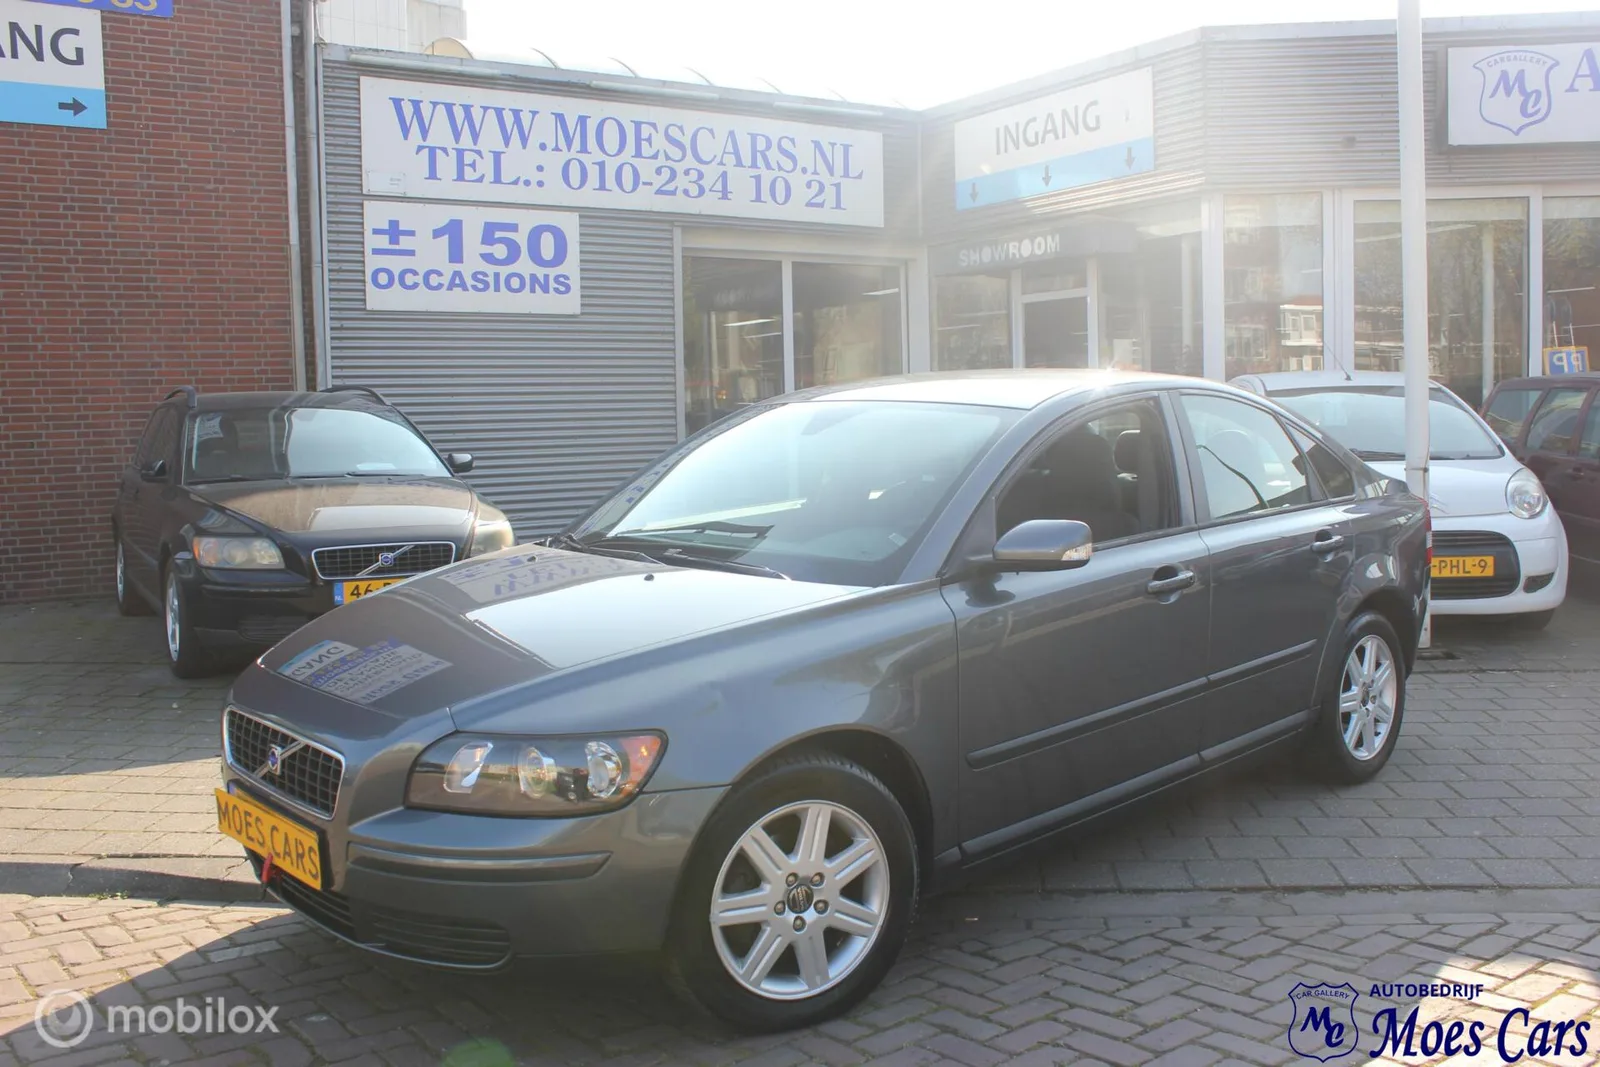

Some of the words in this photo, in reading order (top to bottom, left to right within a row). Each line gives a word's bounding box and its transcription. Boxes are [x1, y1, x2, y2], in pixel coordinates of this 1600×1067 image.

[0, 21, 84, 65] NG
[389, 97, 863, 180] WWW.MOESCARS.NL
[995, 100, 1101, 156] INGANG
[416, 145, 544, 188] TEL.:
[562, 157, 733, 201] 010-234
[750, 174, 792, 206] 10
[804, 179, 847, 211] 21
[958, 234, 1060, 267] SHOWROOM
[371, 267, 572, 296] OCCASIONS
[216, 796, 266, 848] MOES
[270, 824, 319, 881] CARS
